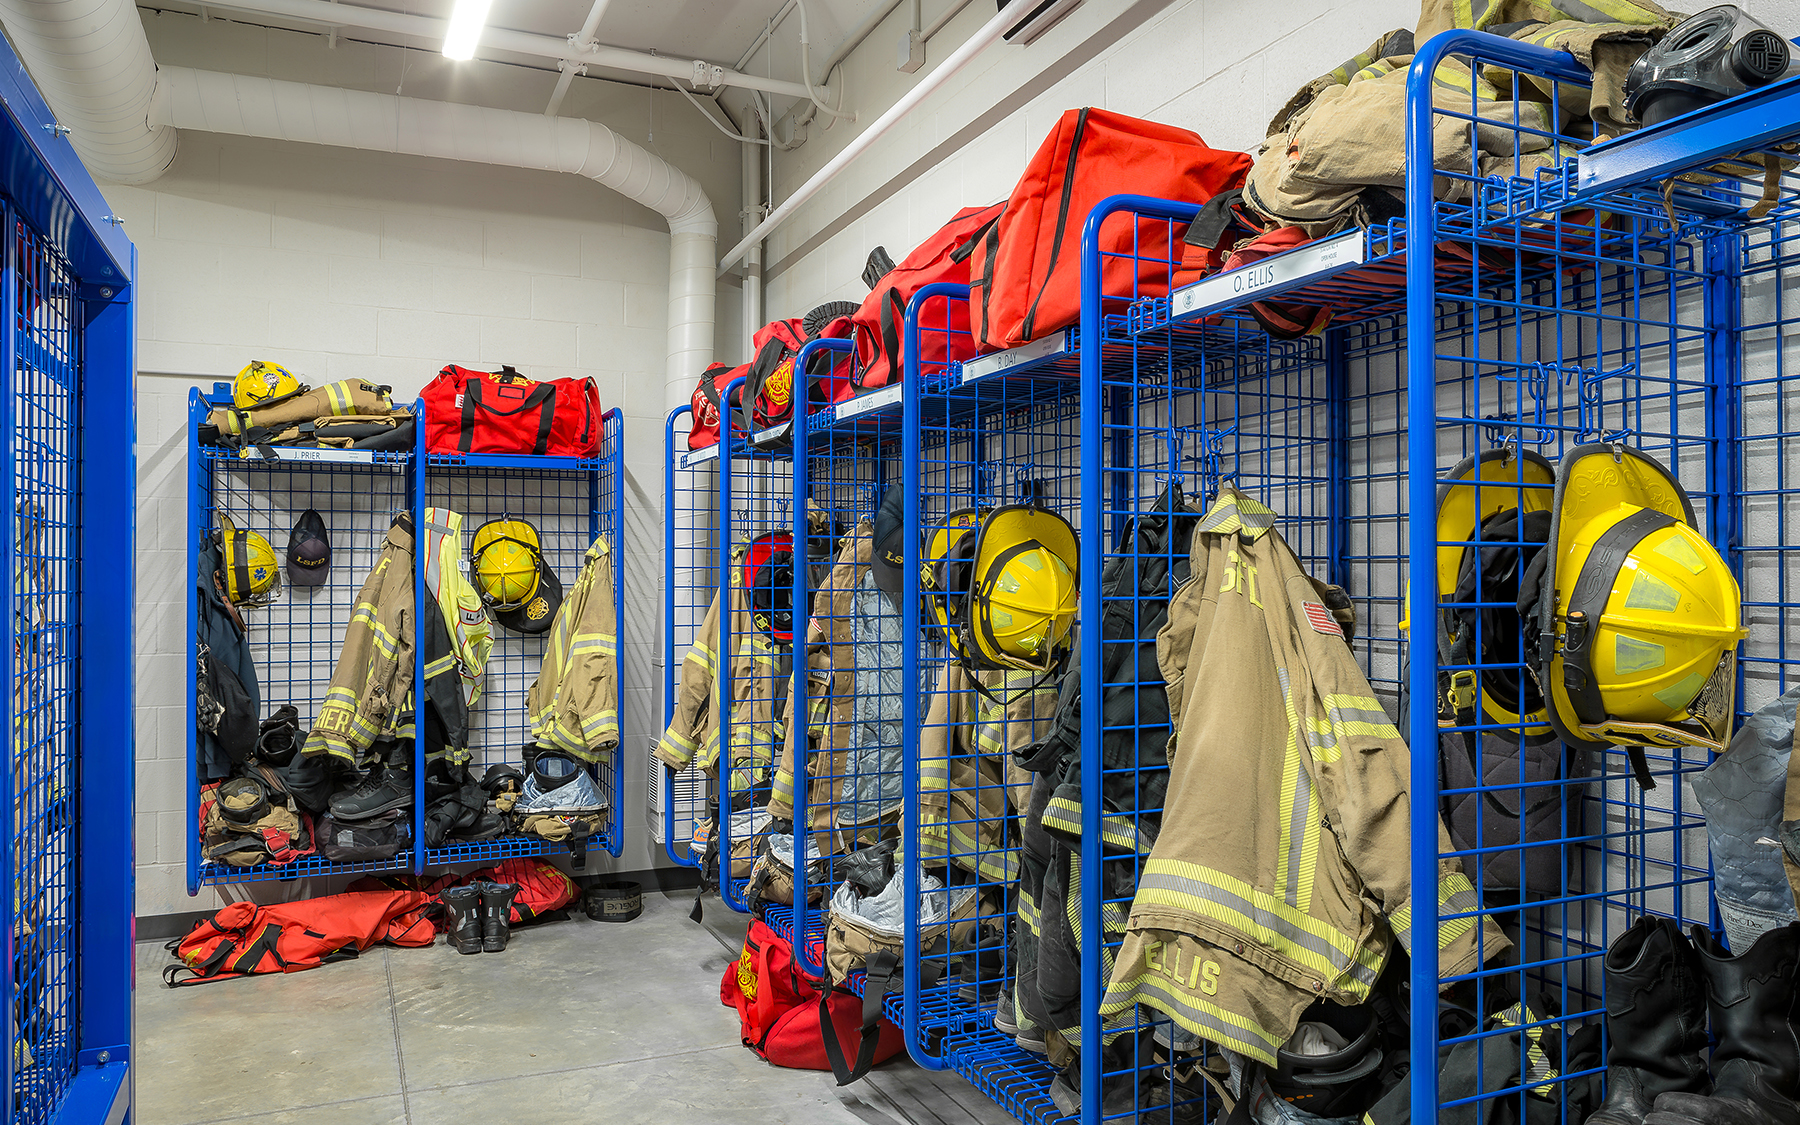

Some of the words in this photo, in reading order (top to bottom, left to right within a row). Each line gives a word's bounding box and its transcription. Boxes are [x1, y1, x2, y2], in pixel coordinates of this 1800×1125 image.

[1233, 274, 1245, 293] O.
[1248, 265, 1274, 289] ELLIS
[1005, 351, 1018, 367] DAY
[294, 451, 299, 459] J.
[301, 451, 321, 460] PRIER
[296, 555, 326, 566] LSFD
[885, 550, 904, 564] LS
[314, 707, 351, 733] IER
[606, 898, 639, 911] ROGUE
[1144, 940, 1221, 996] ELLIS
